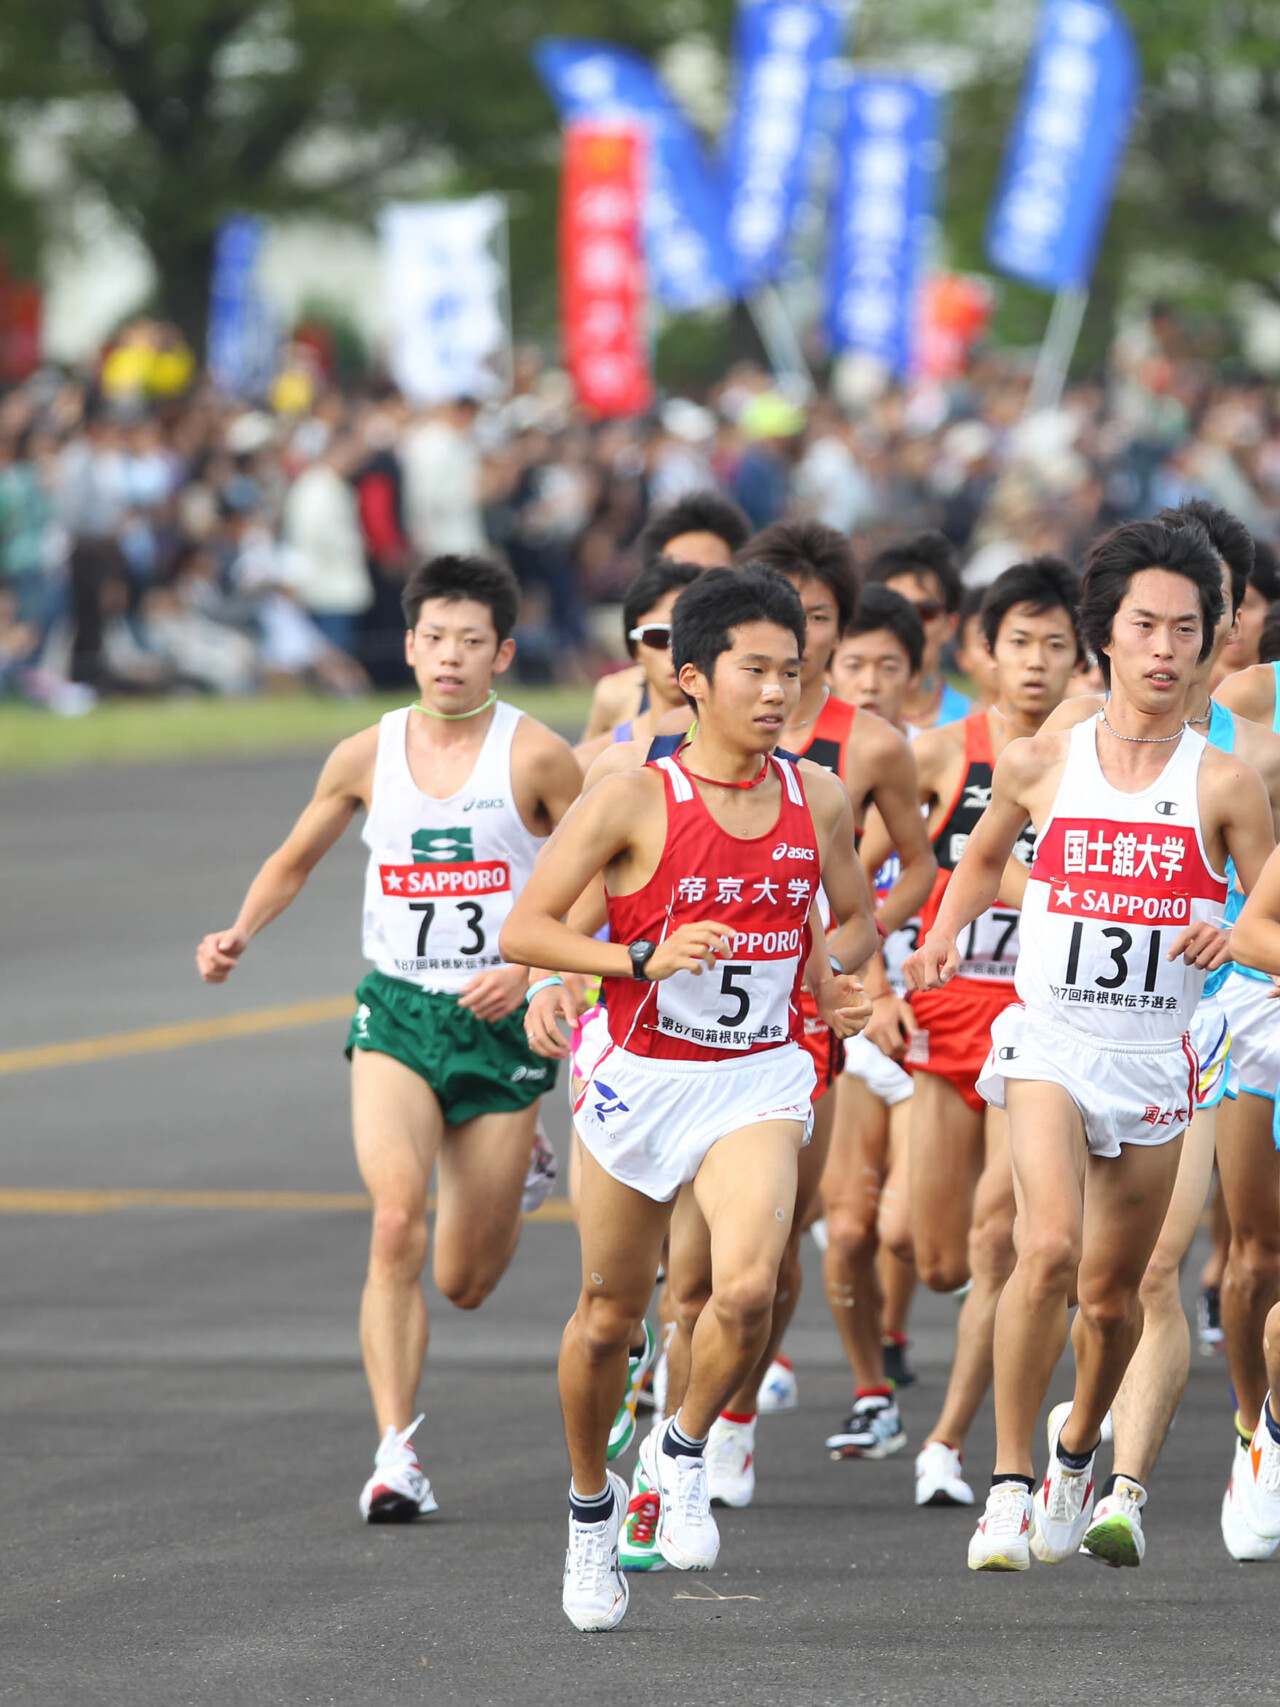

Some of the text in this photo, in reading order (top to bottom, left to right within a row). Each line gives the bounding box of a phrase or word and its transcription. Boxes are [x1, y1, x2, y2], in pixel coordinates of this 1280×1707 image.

[787, 845, 815, 861] asics
[1064, 829, 1186, 882] 国士舘大学
[407, 867, 506, 893] SAPPORO
[677, 875, 811, 906] 帝京大学
[1081, 889, 1187, 919] SAPPORO
[408, 901, 486, 957] 73
[709, 928, 799, 954] PPORO
[1065, 921, 1161, 992] 131
[716, 965, 752, 1027] 5
